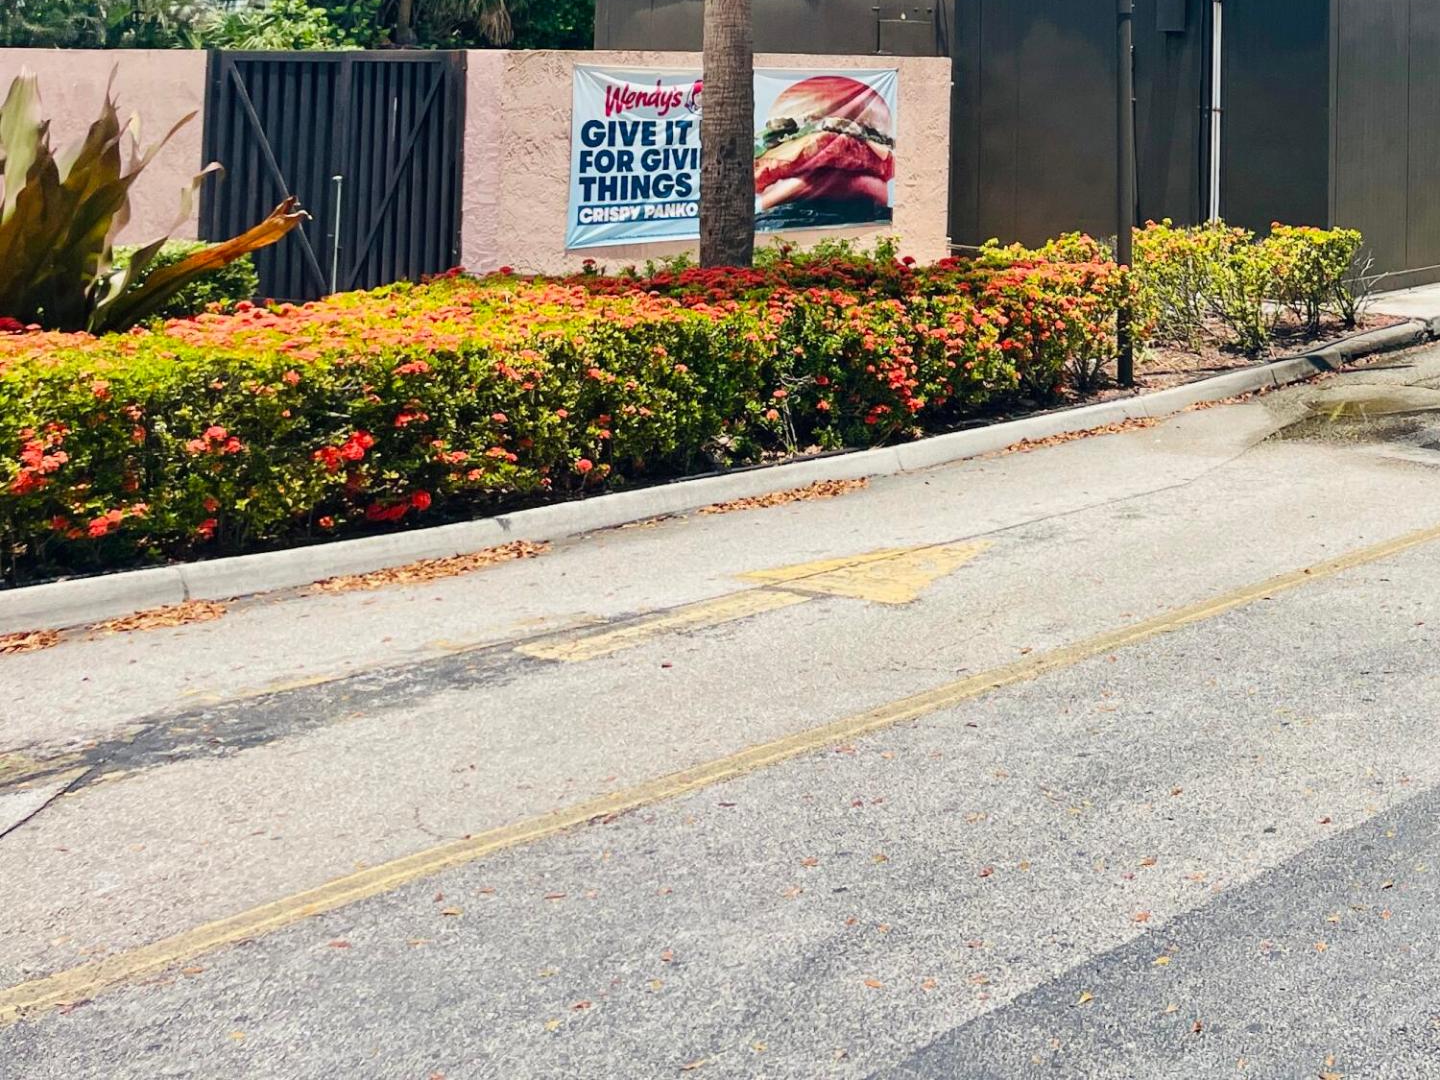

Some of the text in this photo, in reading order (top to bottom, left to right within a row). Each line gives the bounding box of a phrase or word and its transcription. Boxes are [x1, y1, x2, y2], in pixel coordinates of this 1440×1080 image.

[605, 80, 683, 117] Wendy's
[580, 119, 693, 148] GIVE IT
[579, 147, 700, 174] FOR GIVI
[578, 172, 693, 202] THINGS
[579, 201, 699, 224] CRISPY PANKO
